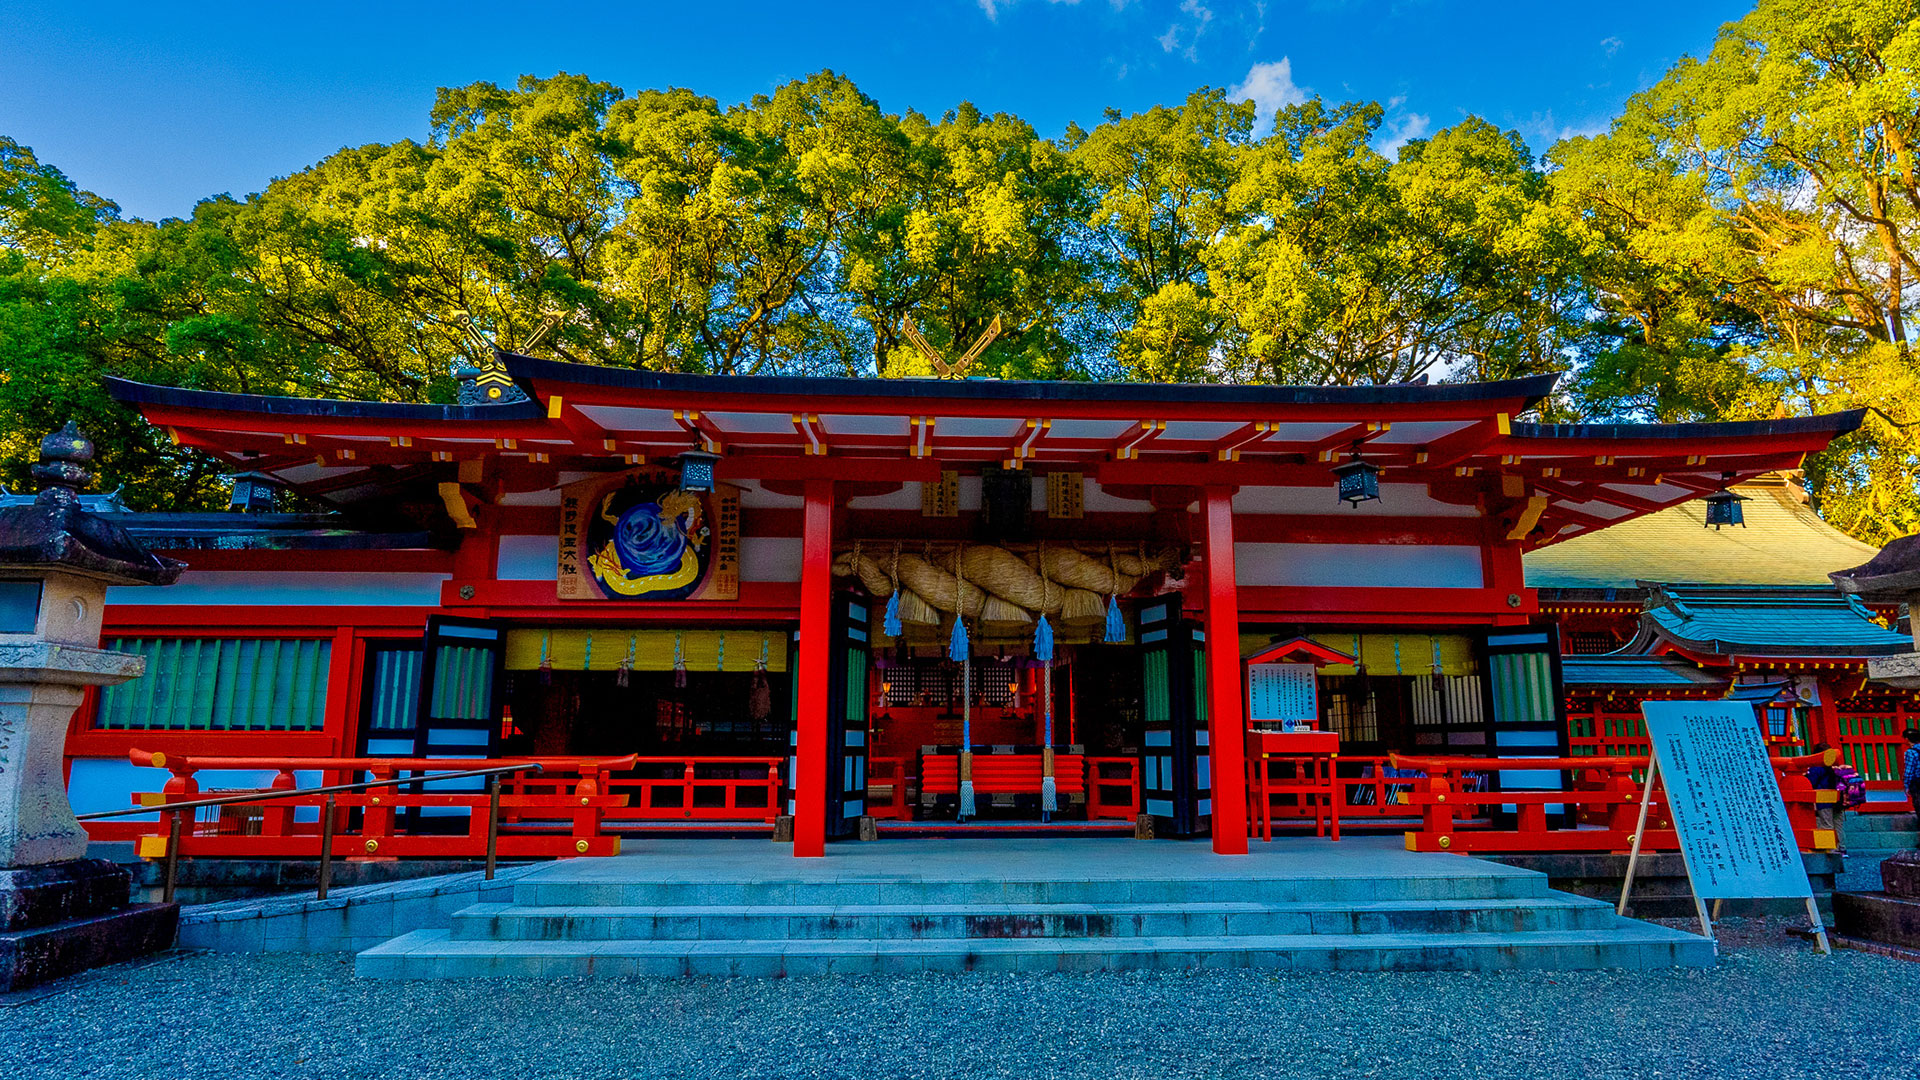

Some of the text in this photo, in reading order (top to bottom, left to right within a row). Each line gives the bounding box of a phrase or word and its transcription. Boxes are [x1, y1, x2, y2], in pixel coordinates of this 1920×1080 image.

[562, 497, 579, 575] 熊野速玉大社
